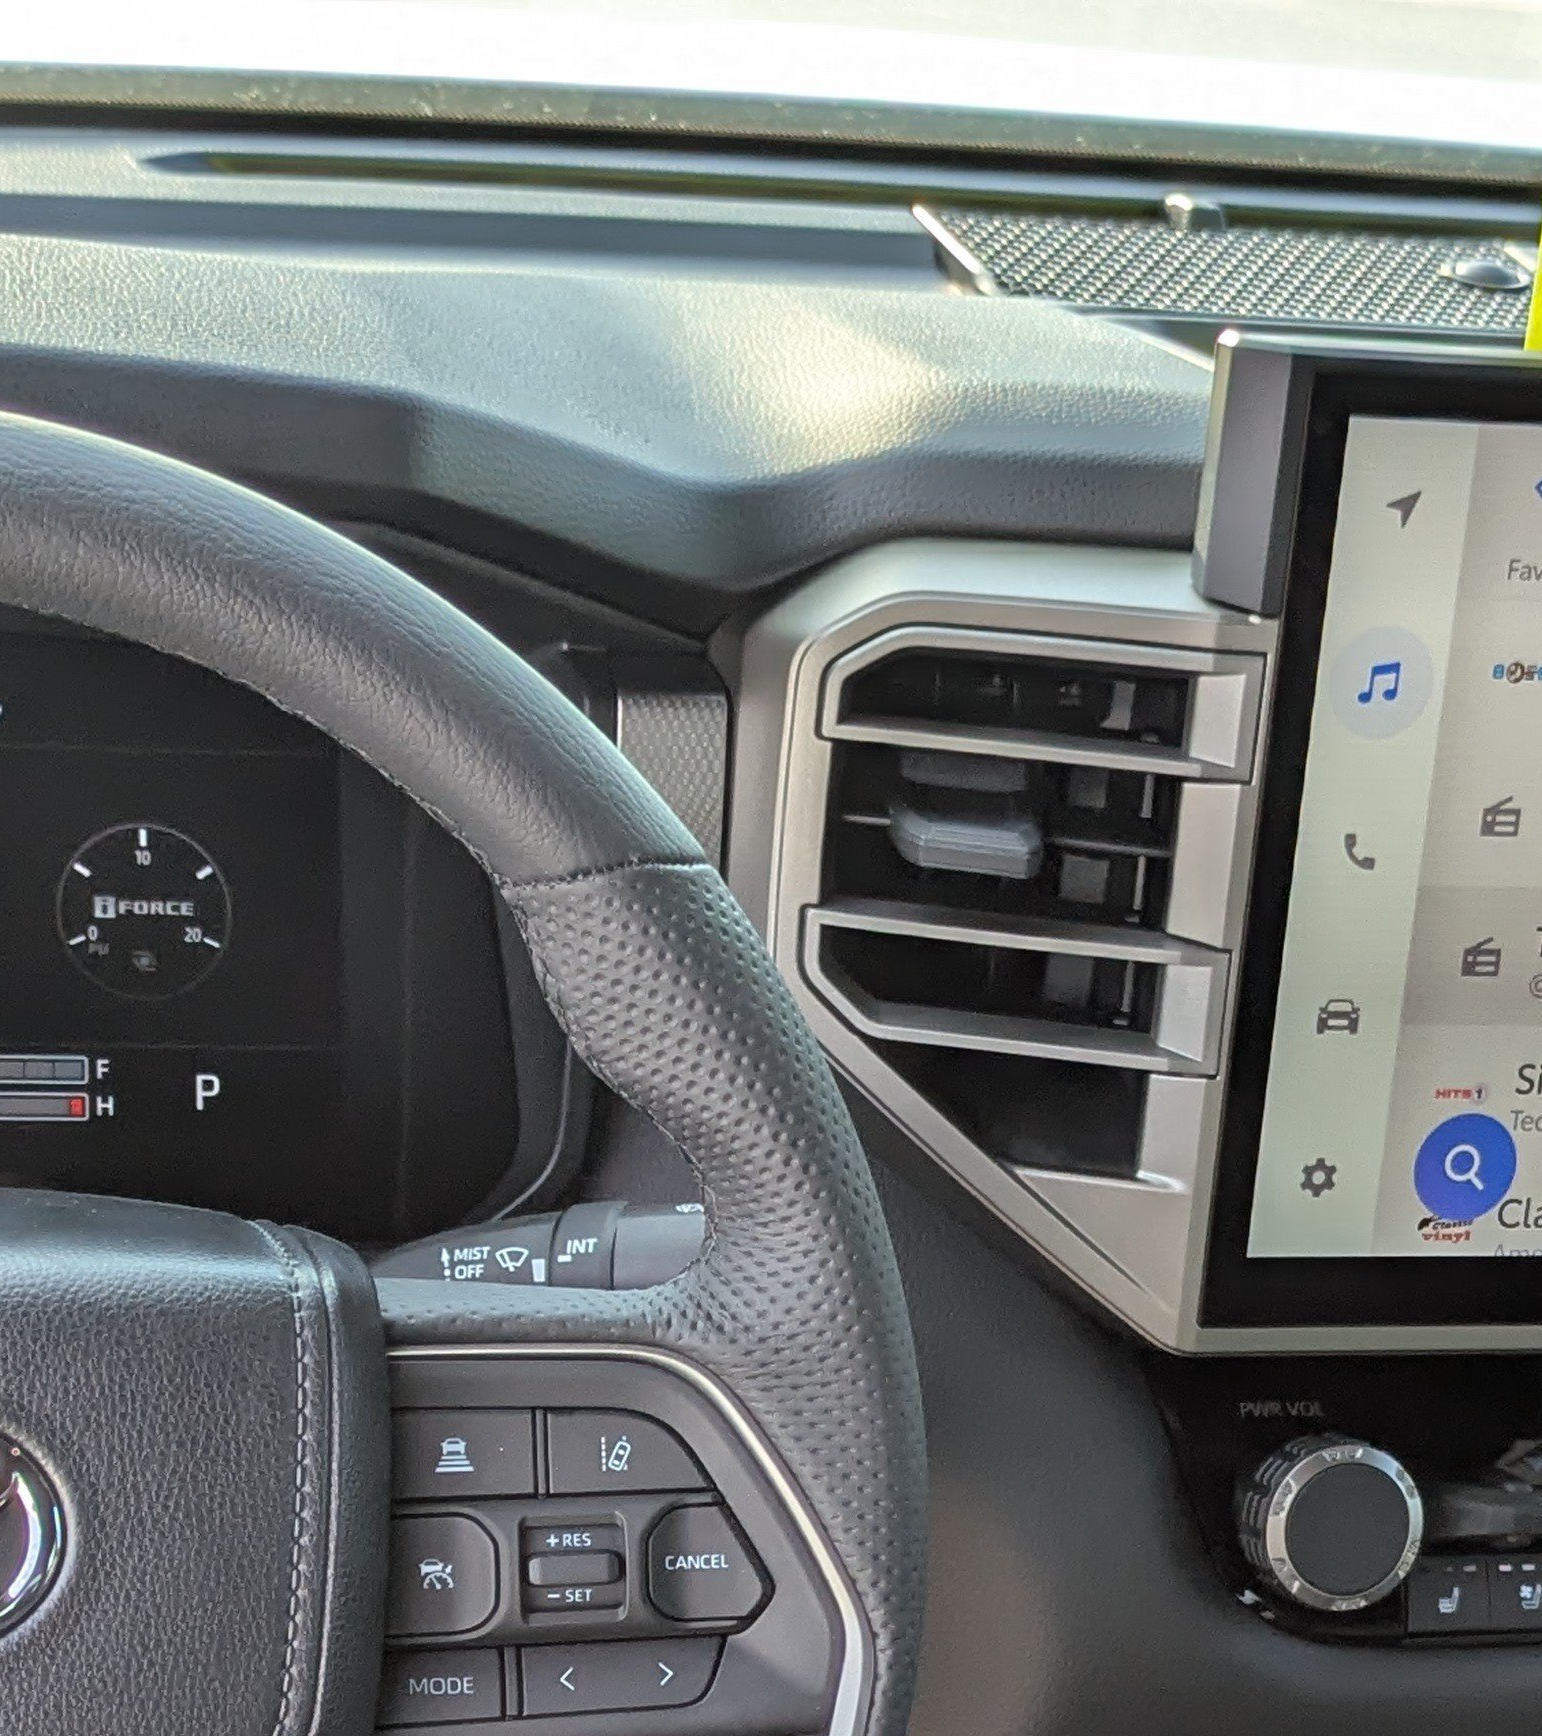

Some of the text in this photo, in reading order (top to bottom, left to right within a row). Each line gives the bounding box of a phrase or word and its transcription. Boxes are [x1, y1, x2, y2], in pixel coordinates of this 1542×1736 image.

[133, 849, 152, 867] 10
[185, 926, 202, 942] 20
[96, 1059, 109, 1079] F
[196, 1074, 221, 1110] P
[96, 1098, 114, 1116] H
[454, 1245, 490, 1263] MIST
[566, 1238, 598, 1255] INT
[454, 1263, 485, 1279] OFF
[665, 1555, 729, 1570] CANCEL
[565, 1588, 593, 1603] SET
[408, 1677, 474, 1696] MODE
